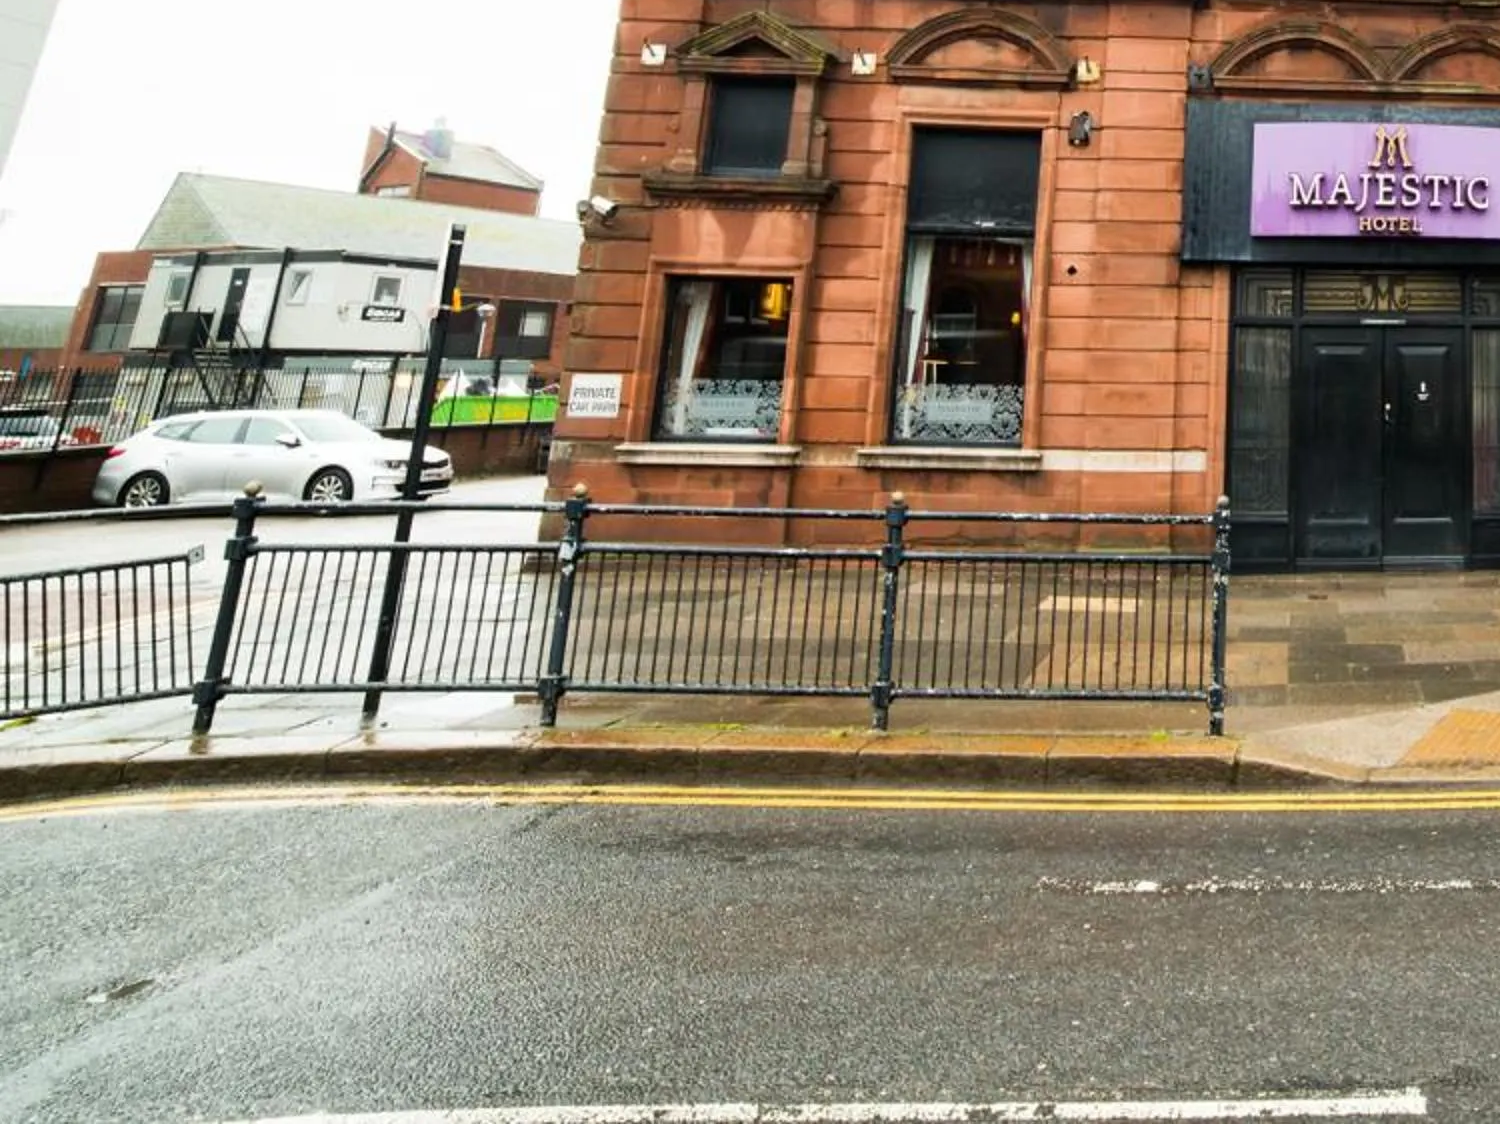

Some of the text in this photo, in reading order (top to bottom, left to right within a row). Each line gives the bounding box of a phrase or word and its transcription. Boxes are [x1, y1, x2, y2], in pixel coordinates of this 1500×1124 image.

[1368, 124, 1414, 169] M
[1289, 174, 1490, 211] MAJESTIC
[1359, 216, 1423, 233] HOTEL
[574, 387, 616, 398] PRIVATE
